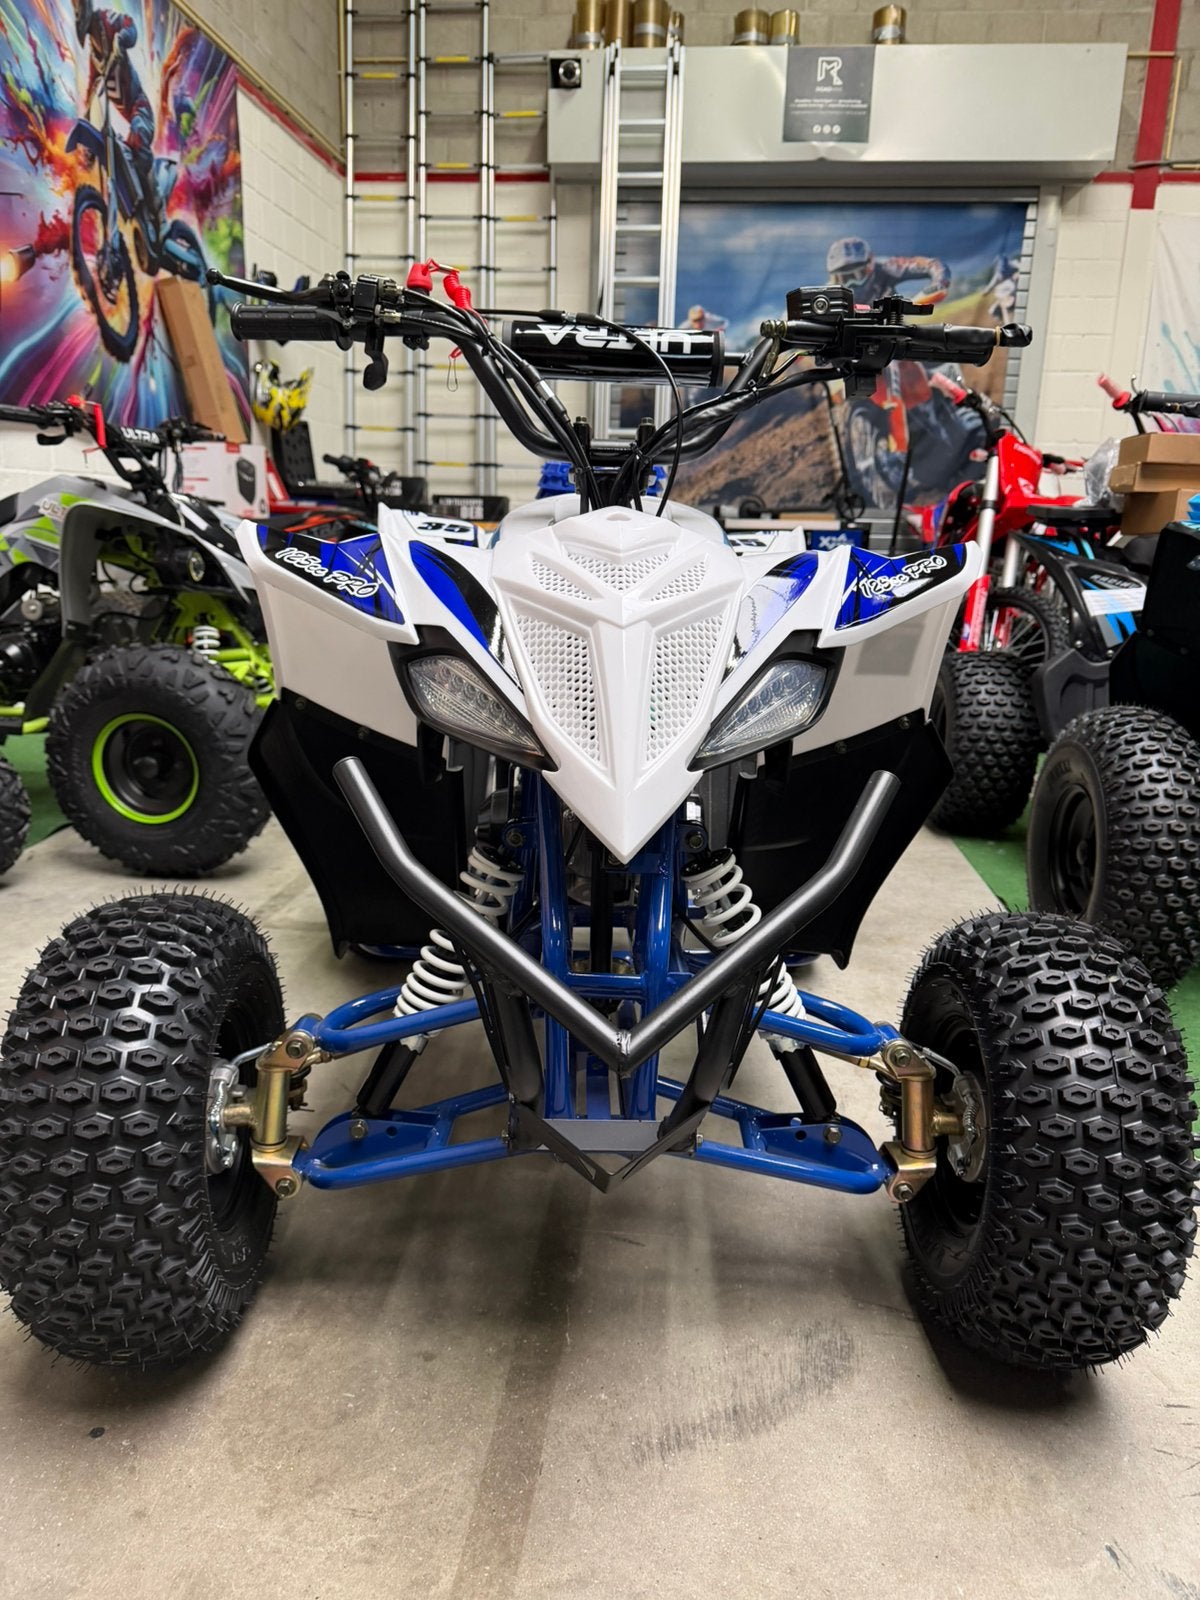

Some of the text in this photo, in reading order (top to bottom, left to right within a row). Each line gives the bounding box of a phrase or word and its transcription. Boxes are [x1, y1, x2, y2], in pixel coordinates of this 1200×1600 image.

[121, 426, 161, 444] ULTRA
[41, 499, 68, 517] ULT
[902, 554, 948, 579] PRO
[323, 570, 379, 598] PRO
